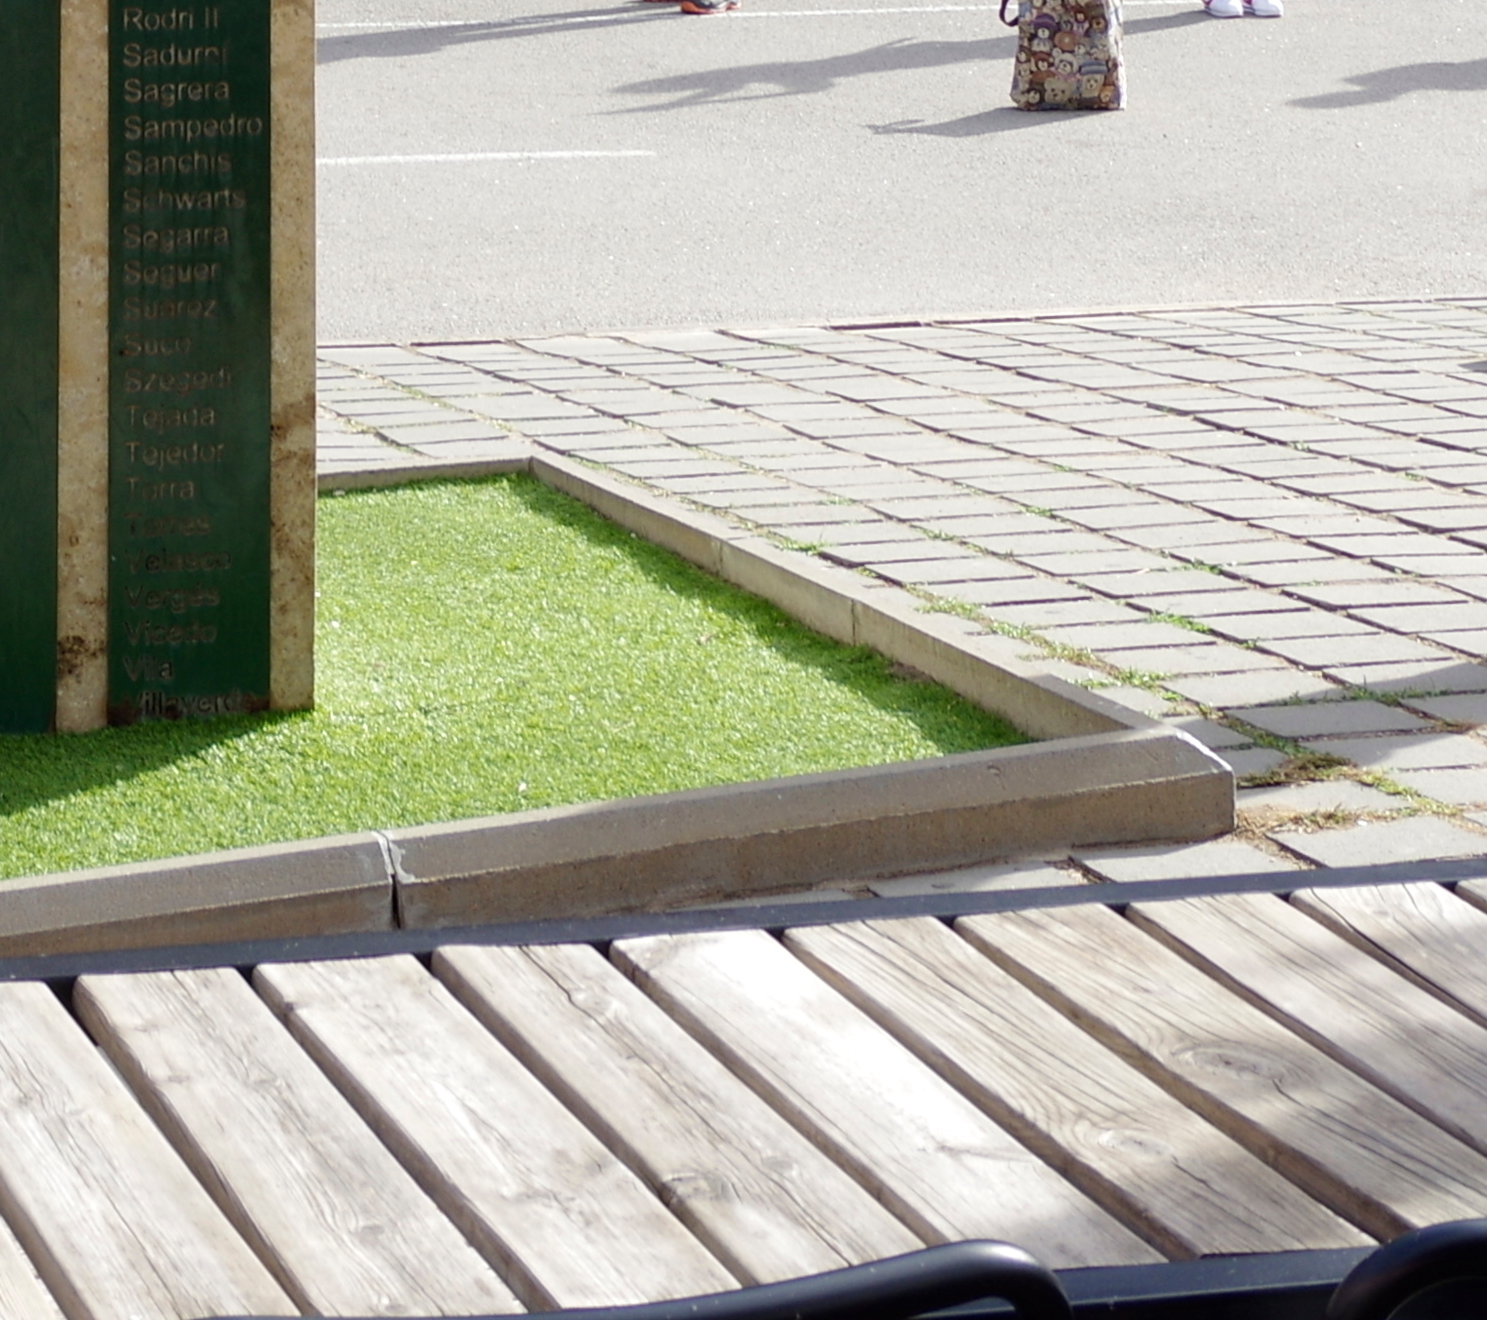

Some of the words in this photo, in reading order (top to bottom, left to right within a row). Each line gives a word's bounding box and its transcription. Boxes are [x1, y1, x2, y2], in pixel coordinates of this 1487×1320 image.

[123, 7, 194, 32] Rodri
[124, 77, 230, 108] Sagrera
[124, 113, 263, 142] Sampedro
[124, 150, 233, 177] Sanchis
[124, 223, 230, 255] Segarra
